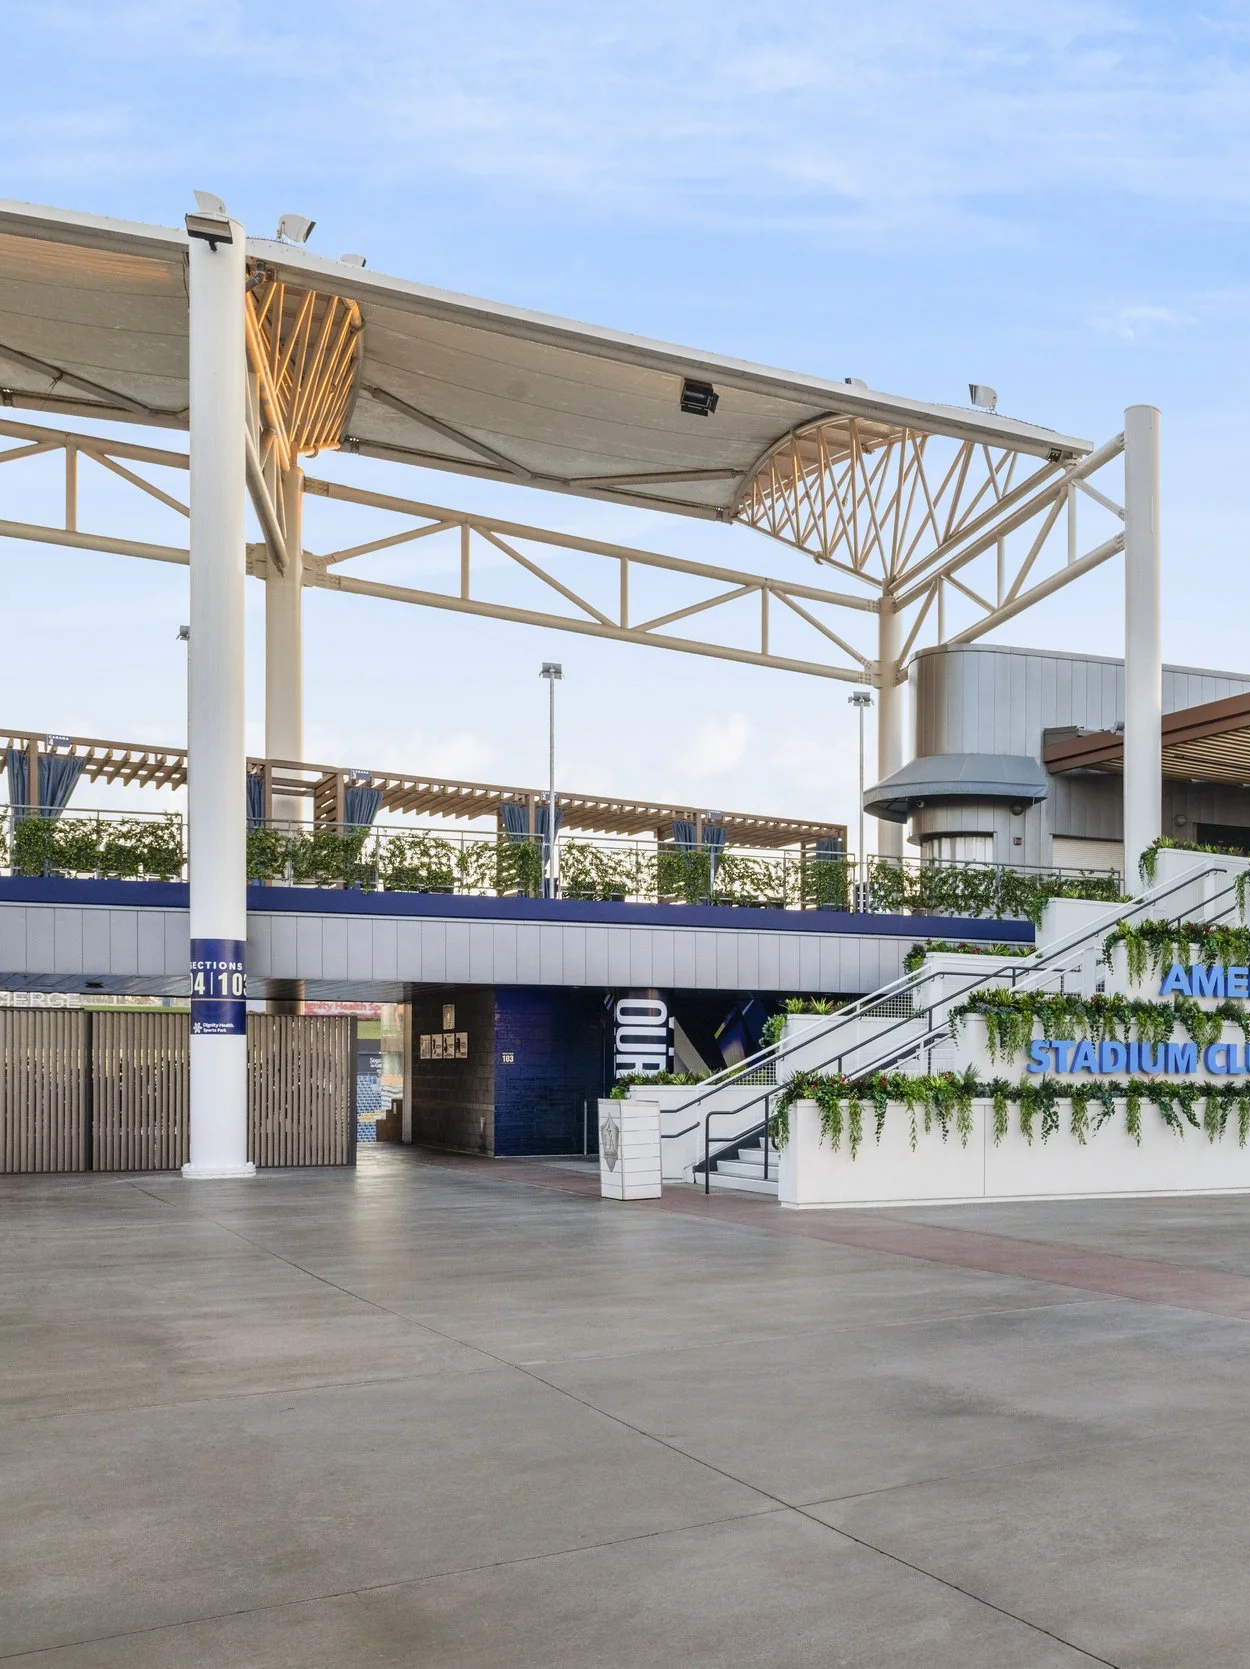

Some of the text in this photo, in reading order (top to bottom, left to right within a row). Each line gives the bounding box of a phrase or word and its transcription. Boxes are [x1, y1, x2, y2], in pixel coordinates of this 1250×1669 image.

[190, 971, 206, 996] 4
[0, 991, 81, 1008] IERGE
[304, 1001, 332, 1010] ignity
[502, 1055, 514, 1063] 103
[1027, 1039, 1198, 1075] STADIUM
